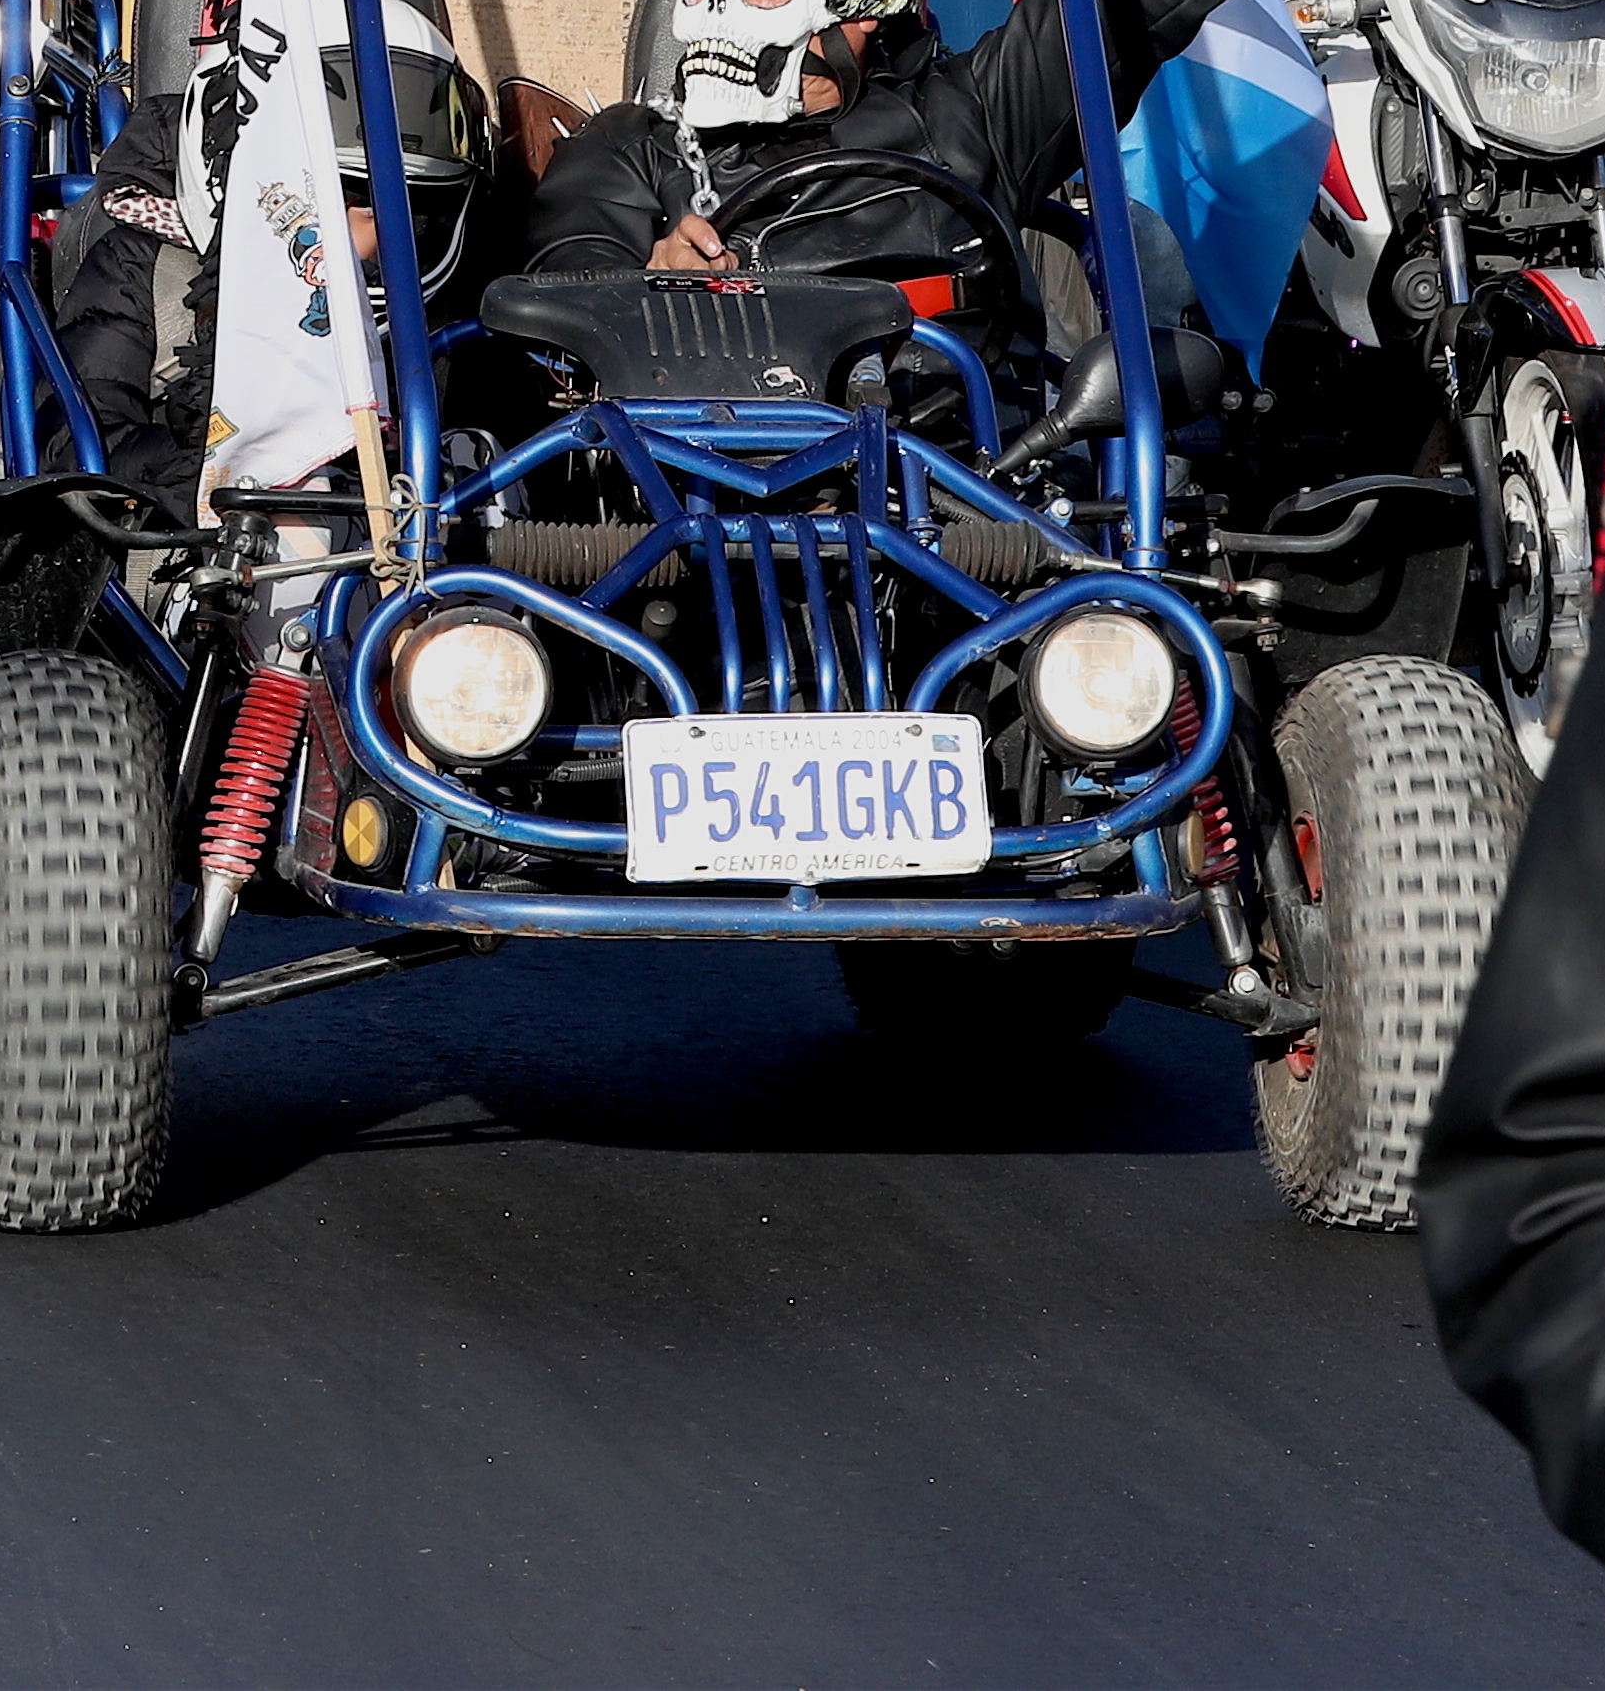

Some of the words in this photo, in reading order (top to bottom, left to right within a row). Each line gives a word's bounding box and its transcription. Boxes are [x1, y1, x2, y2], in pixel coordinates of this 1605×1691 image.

[711, 730, 843, 752] GUATEMALA
[852, 729, 903, 750] 2004
[649, 760, 967, 844] P541GKB
[712, 854, 798, 872] CENTRO
[809, 849, 905, 872] AMÉRICA
